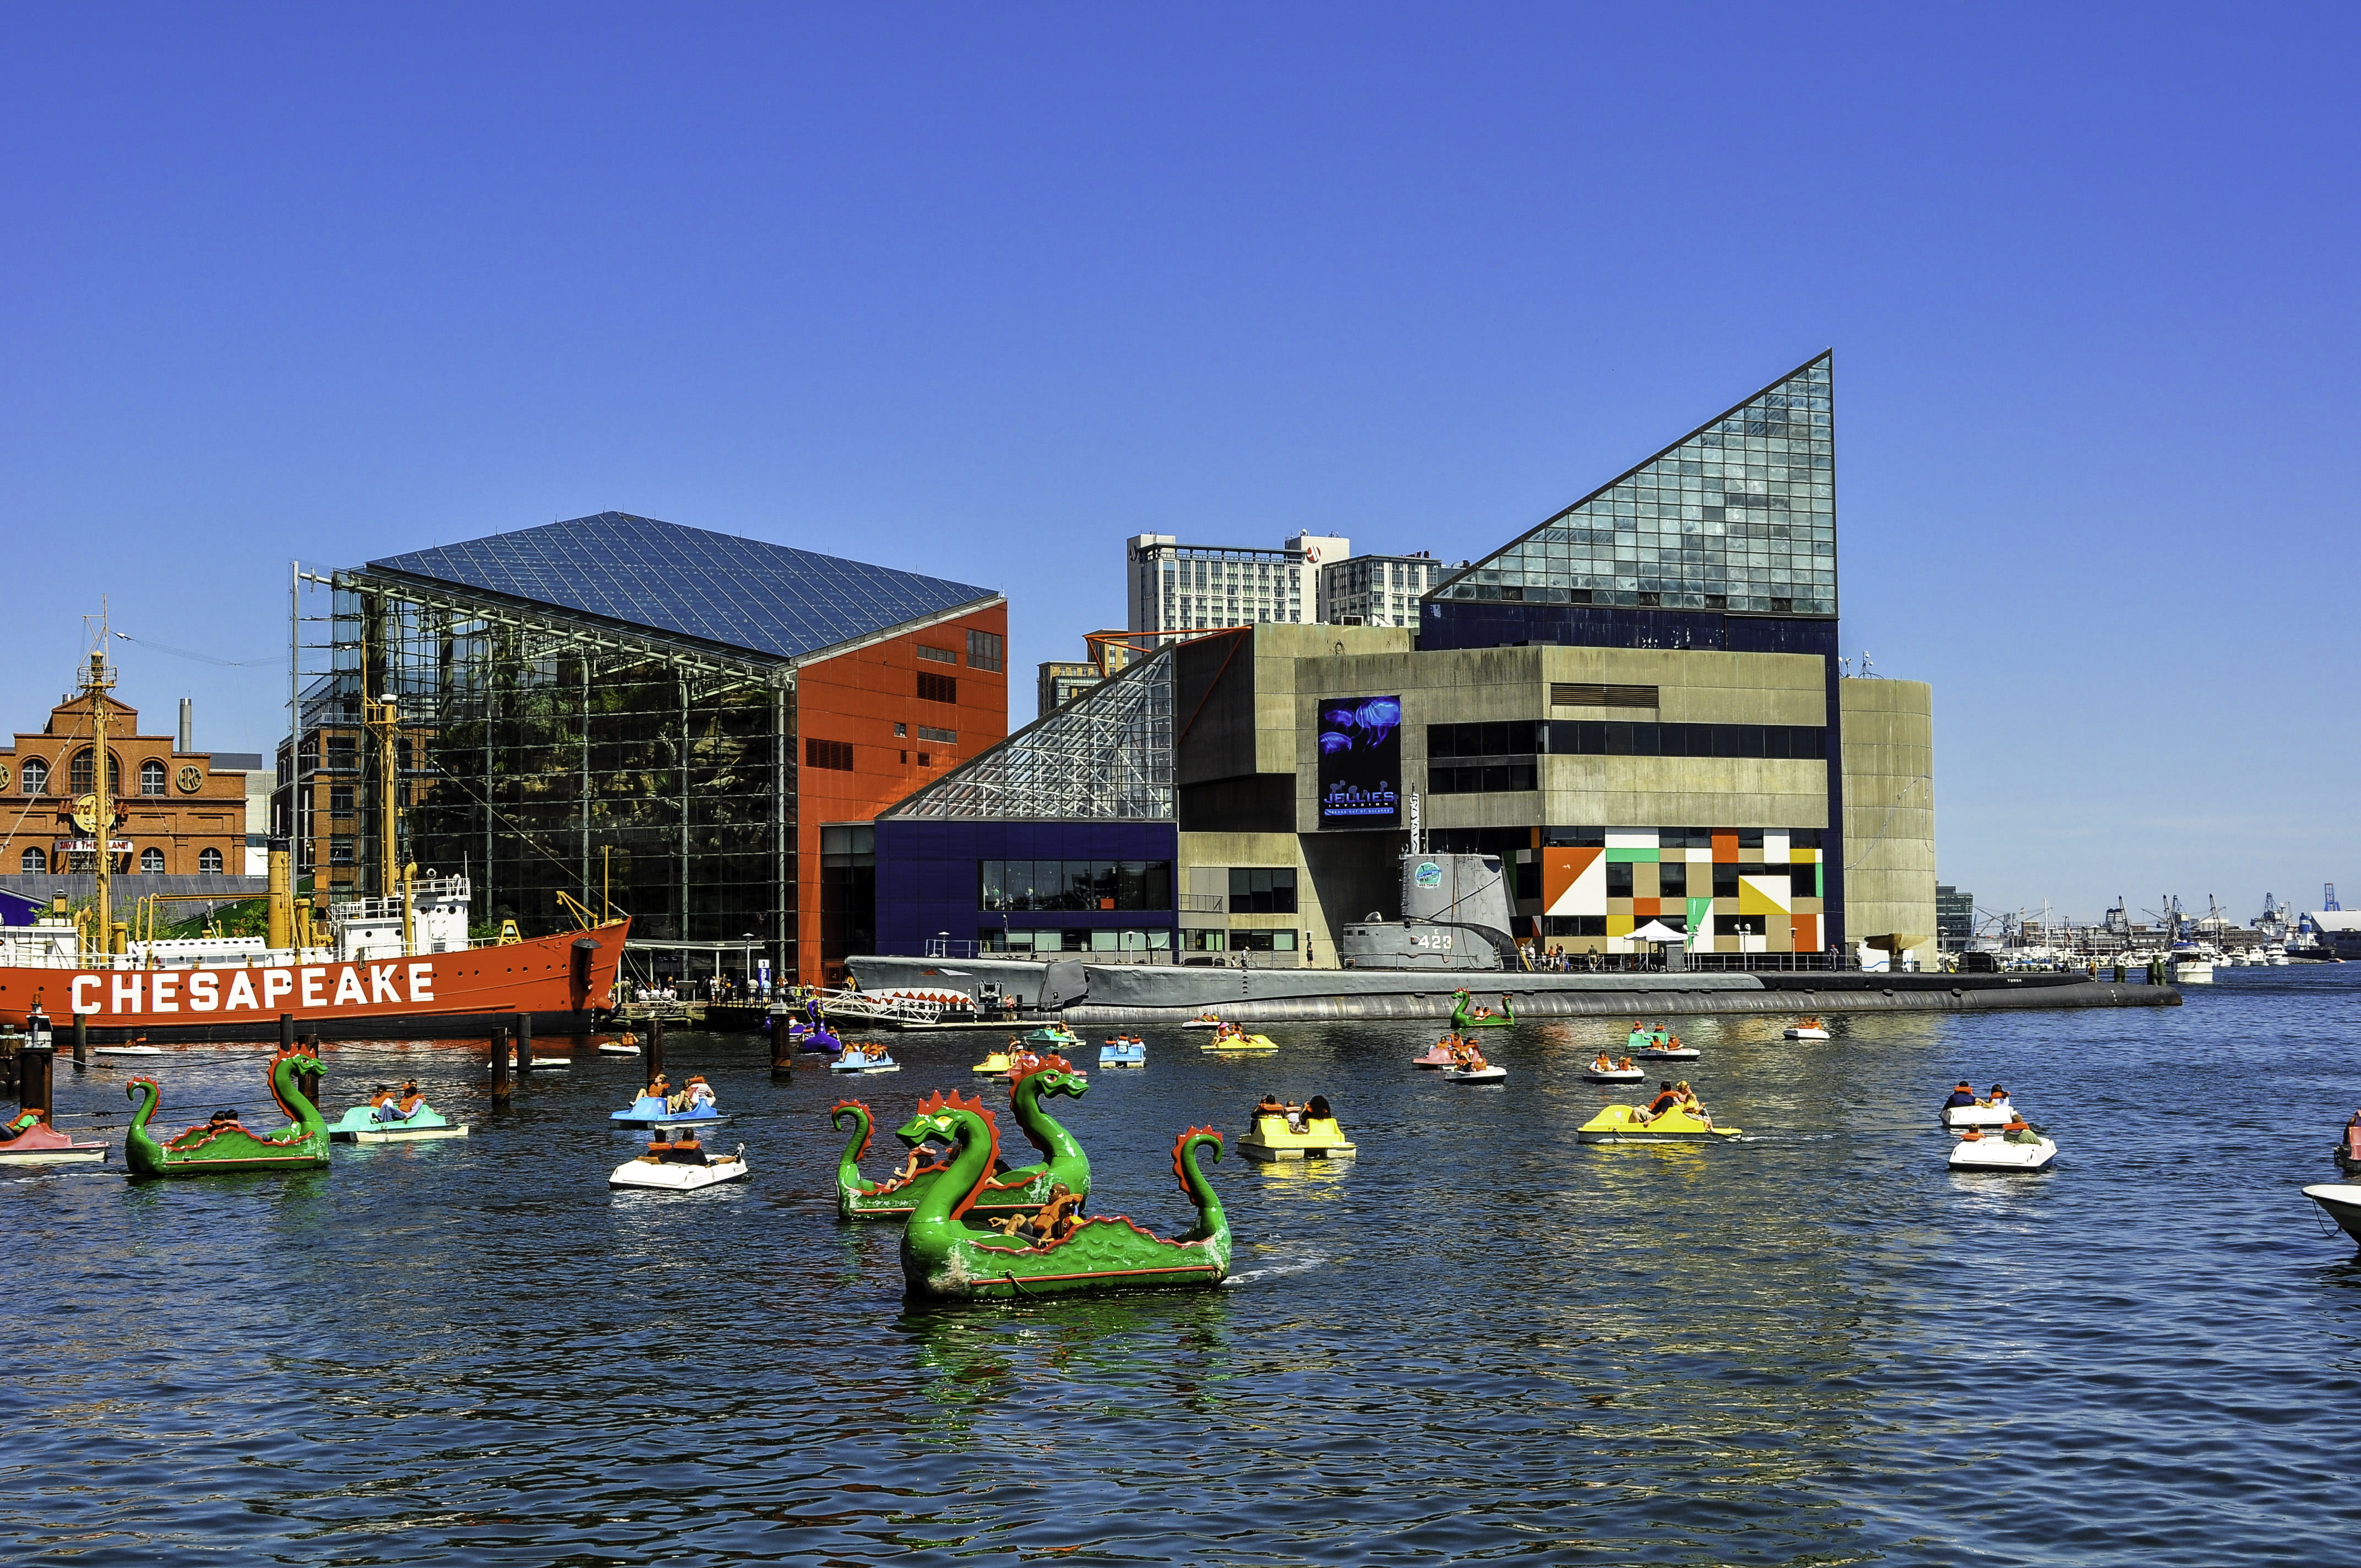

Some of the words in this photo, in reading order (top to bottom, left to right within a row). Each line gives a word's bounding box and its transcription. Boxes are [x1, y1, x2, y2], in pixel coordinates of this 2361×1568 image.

[1324, 792, 1394, 803] JELLIES
[58, 800, 94, 815] Hard
[59, 841, 77, 850] SAVE
[106, 841, 129, 850] LANET
[1418, 935, 1452, 950] 423
[71, 962, 435, 1015] CHESAPEAKE
